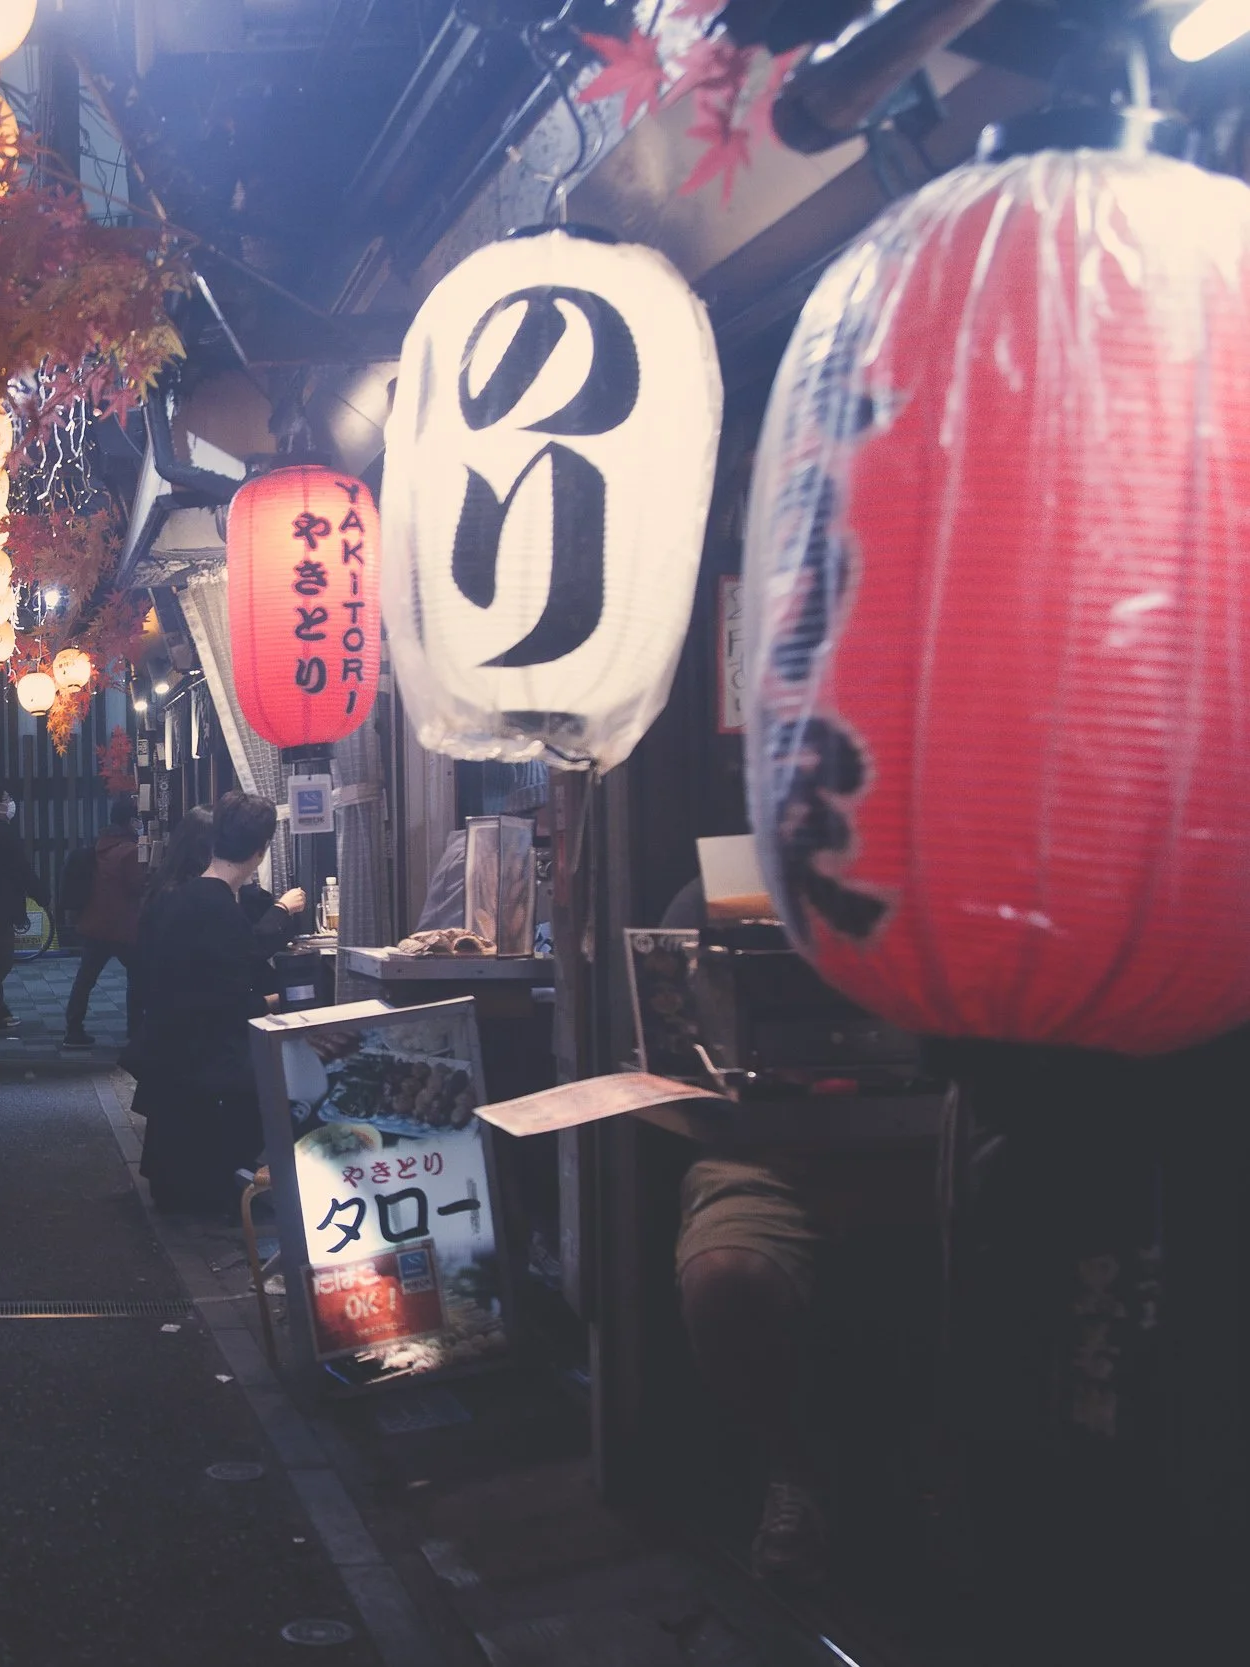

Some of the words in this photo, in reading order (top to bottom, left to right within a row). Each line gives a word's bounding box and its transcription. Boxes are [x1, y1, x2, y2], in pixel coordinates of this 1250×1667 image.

[455, 285, 639, 668] のり
[293, 511, 331, 694] やきとり
[335, 480, 366, 715] YAKITORI
[316, 1187, 481, 1253] タロー
[342, 1152, 444, 1188] やきとり
